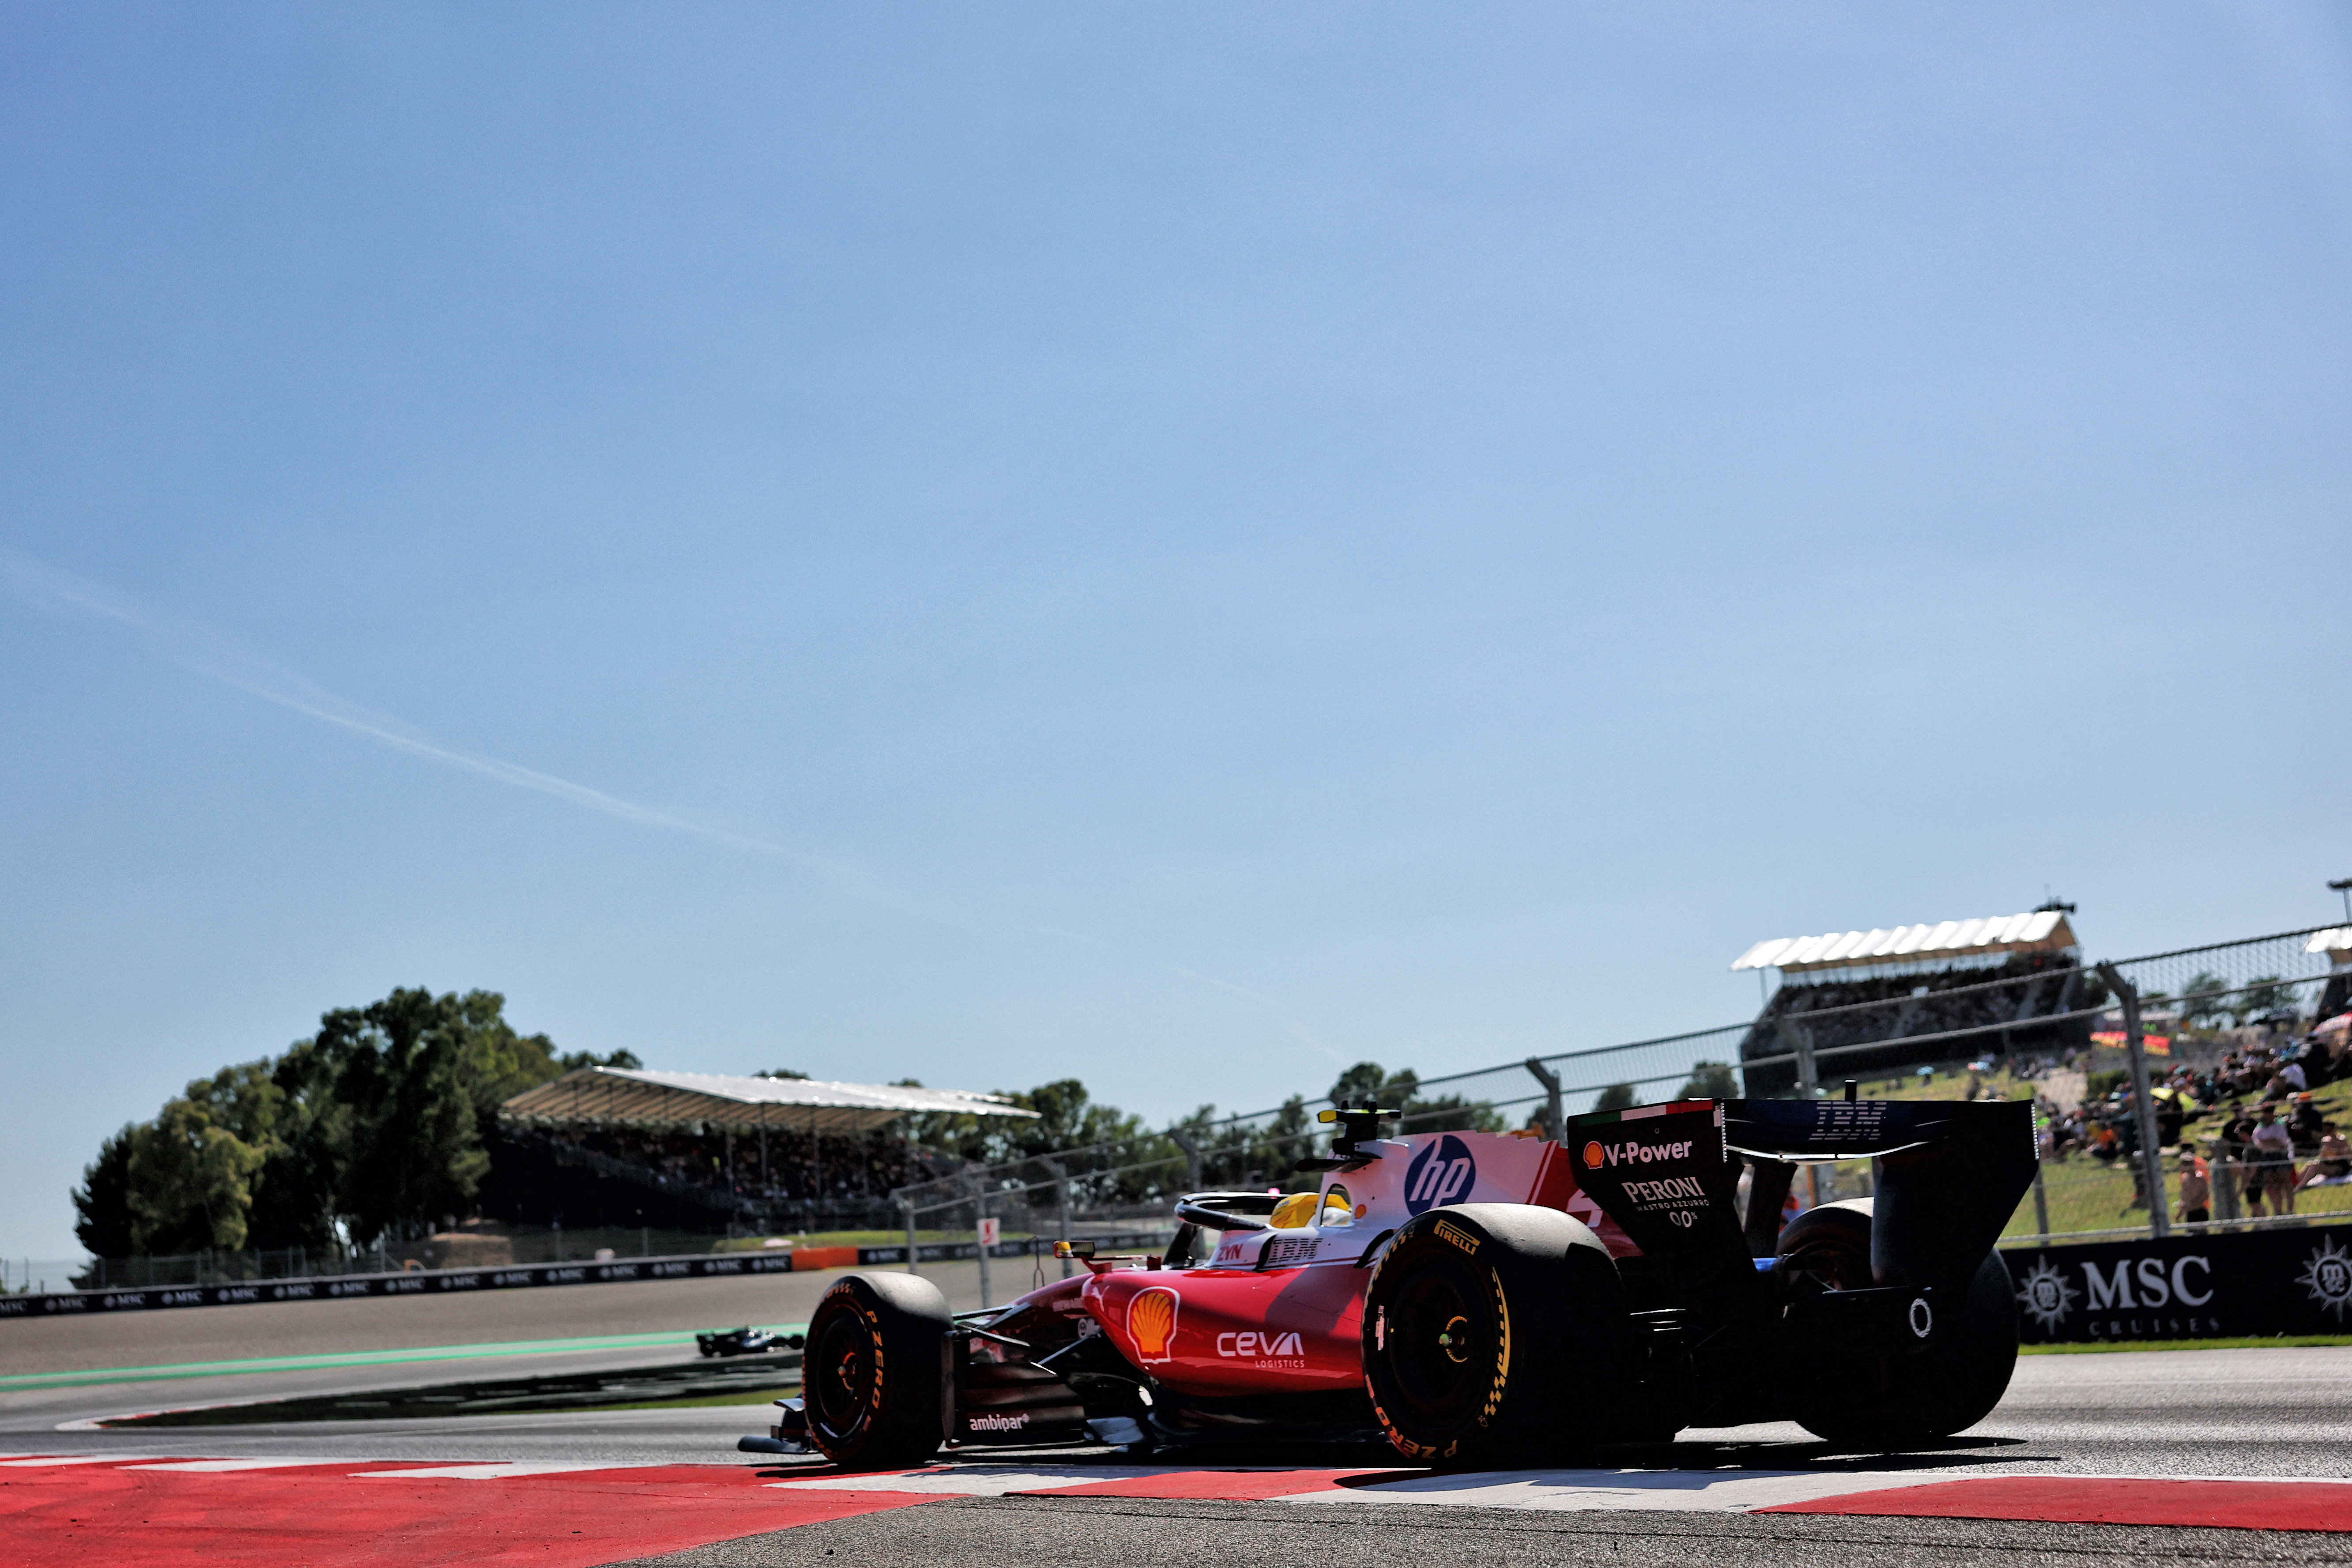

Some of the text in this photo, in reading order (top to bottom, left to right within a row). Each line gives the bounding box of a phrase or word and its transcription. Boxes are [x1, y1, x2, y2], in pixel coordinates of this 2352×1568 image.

[1809, 1101, 1886, 1140] IBM
[1604, 1141, 1692, 1166] V-Power
[1409, 1137, 1471, 1210] hp
[1621, 1176, 1705, 1203] PERONI
[1672, 1199, 1710, 1207] AZZURRO
[1434, 1219, 1481, 1255] PIRELLI
[1216, 1243, 1243, 1262] ZYN
[1268, 1238, 1323, 1263] IBM
[2080, 1255, 2214, 1311] MSC
[2088, 1318, 2220, 1336] CRUISES
[872, 1331, 884, 1409] ZERO
[1255, 1360, 1304, 1368] LOGISTICS
[969, 1413, 1022, 1432] ambipar
[1375, 1406, 1437, 1459] ZERO
